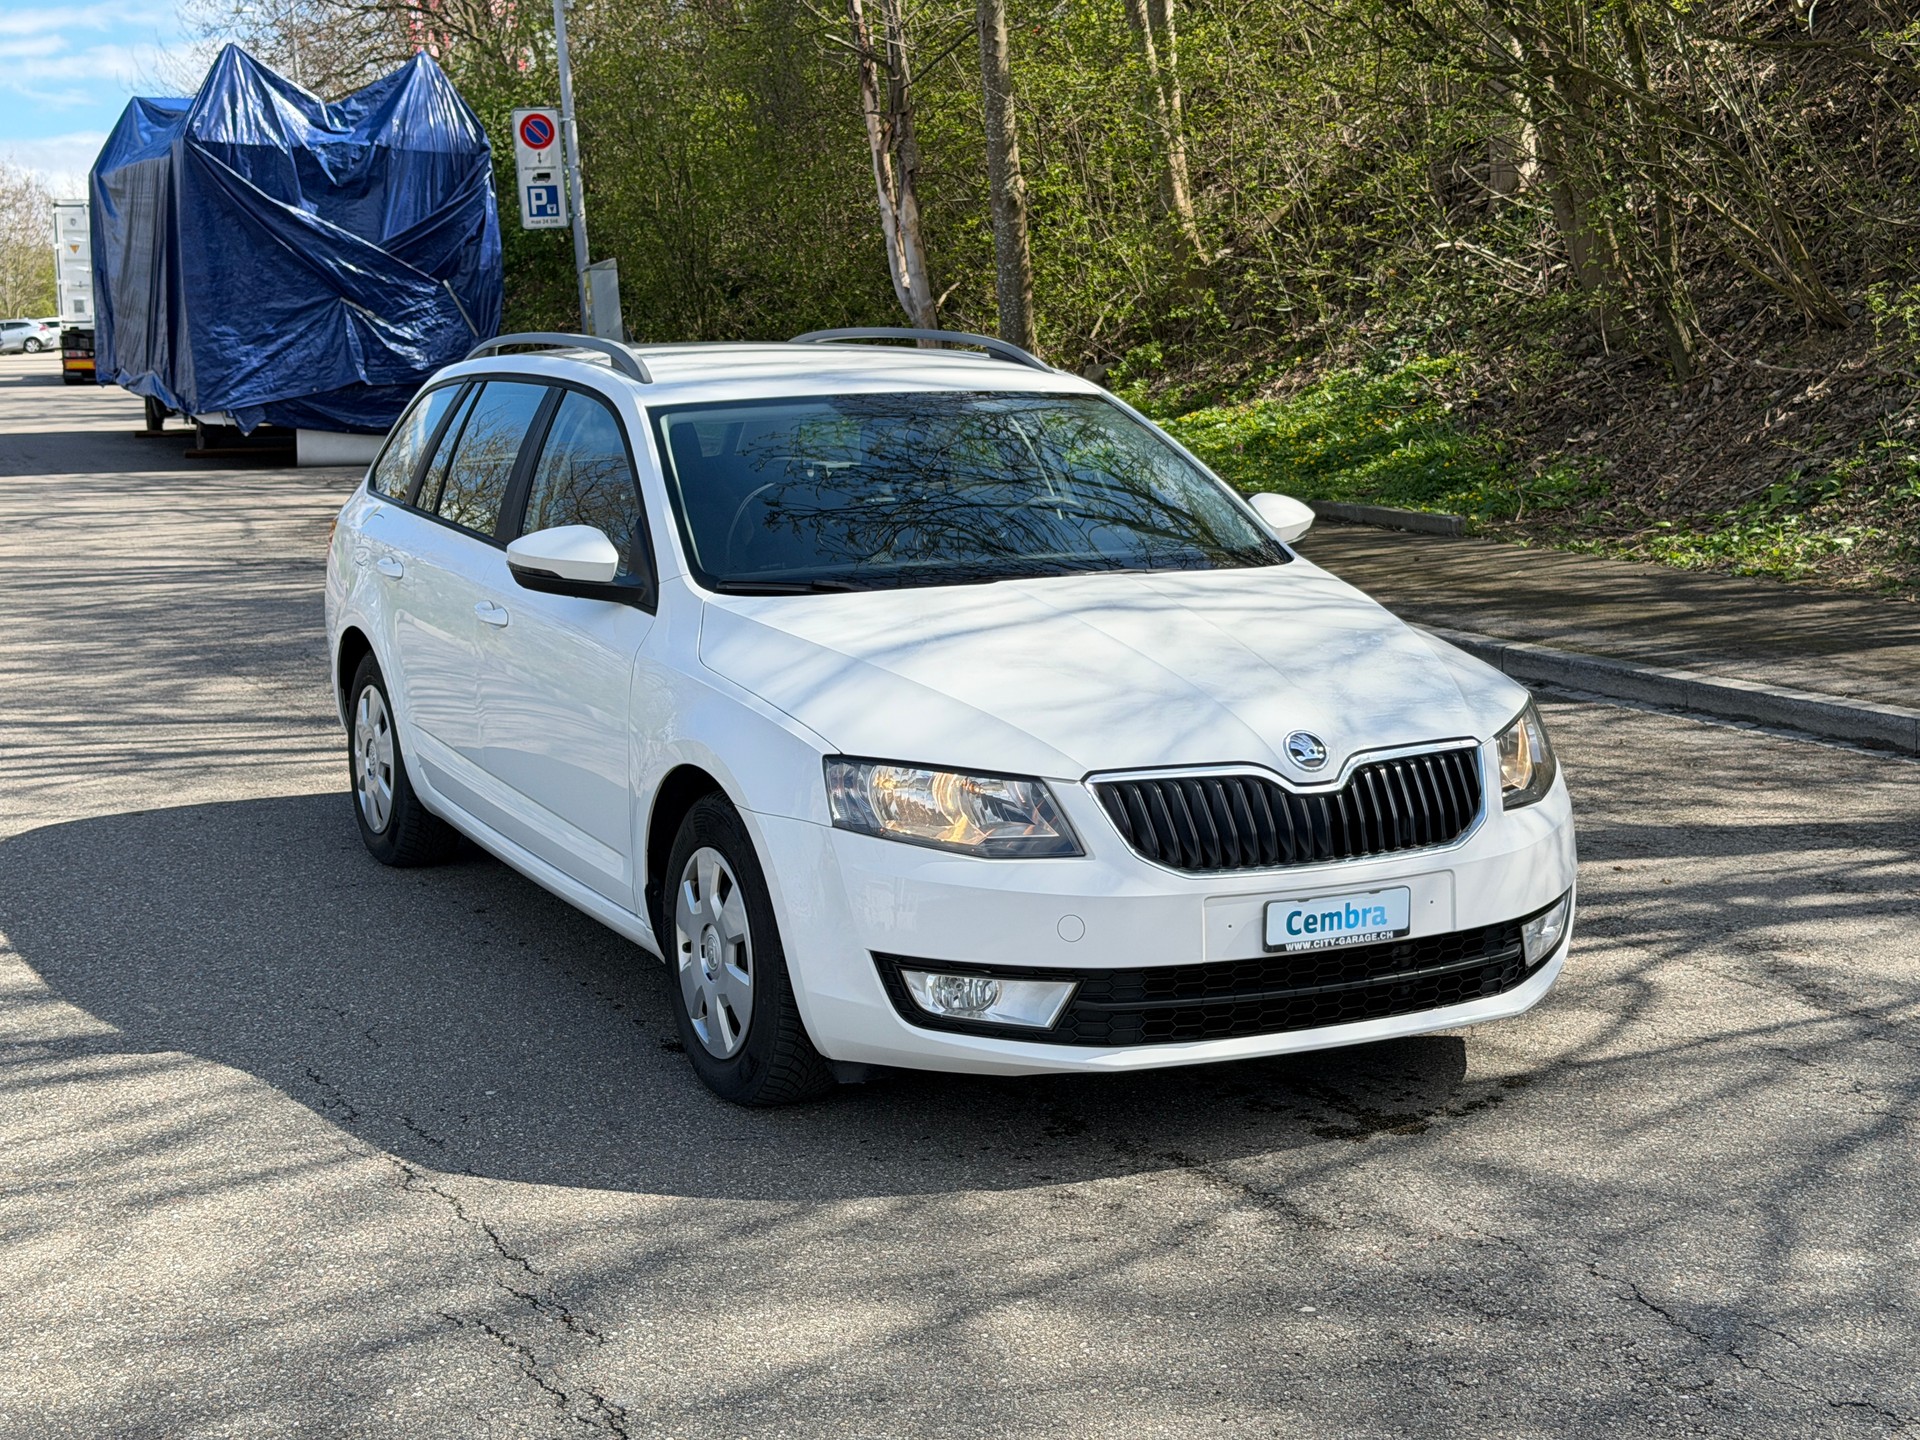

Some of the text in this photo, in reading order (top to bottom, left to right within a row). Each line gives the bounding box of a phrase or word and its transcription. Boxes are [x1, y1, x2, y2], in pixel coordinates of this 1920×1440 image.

[530, 188, 548, 215] P
[1286, 902, 1388, 936] Cembra
[1285, 931, 1394, 952] WWW.CITY-GARAGE.CH
